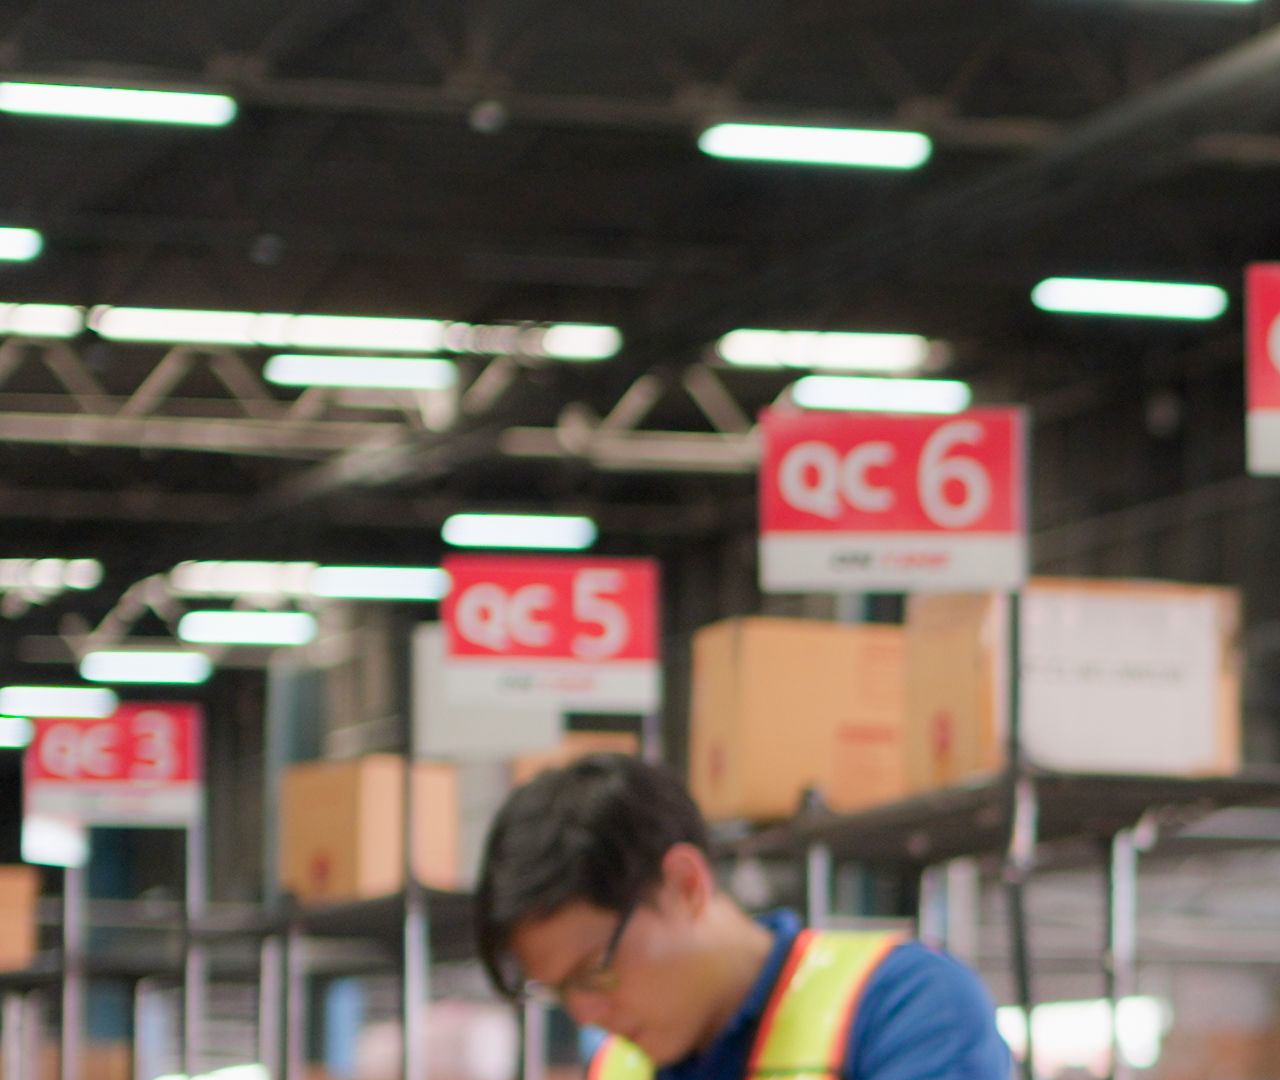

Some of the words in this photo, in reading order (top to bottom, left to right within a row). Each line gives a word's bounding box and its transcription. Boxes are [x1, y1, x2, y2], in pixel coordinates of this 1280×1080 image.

[778, 440, 897, 521] QC
[916, 419, 992, 530] 6
[454, 581, 559, 652] QC
[571, 566, 629, 662] 5
